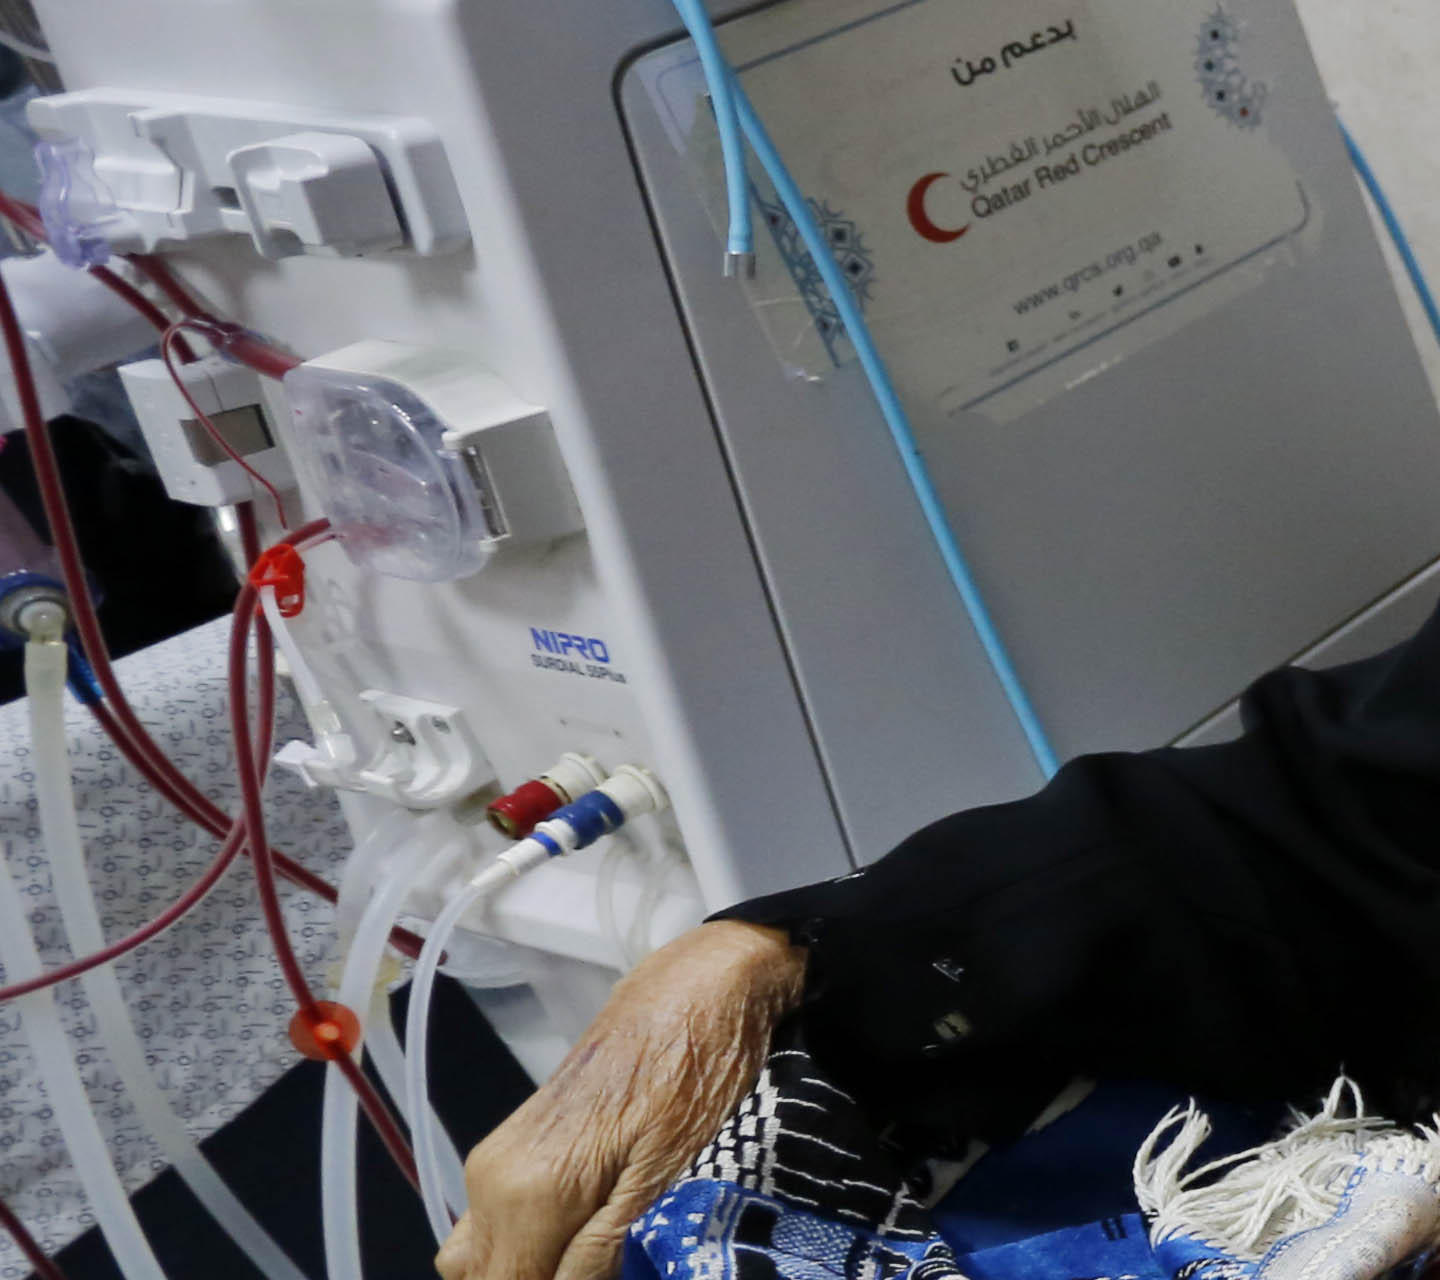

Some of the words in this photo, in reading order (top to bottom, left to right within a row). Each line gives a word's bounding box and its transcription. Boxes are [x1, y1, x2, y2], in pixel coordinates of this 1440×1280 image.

[1000, 19, 1077, 69] بدعم
[951, 57, 997, 87] من
[1103, 81, 1162, 126] الهلال
[1043, 106, 1103, 155] الأحمر
[960, 136, 1041, 194] القطري
[971, 179, 1032, 218] Qatar
[1035, 153, 1081, 188] Red
[1081, 112, 1173, 166] Crescent
[1011, 229, 1164, 317] www.qrcs.org.qa
[530, 627, 610, 664] NIPRO
